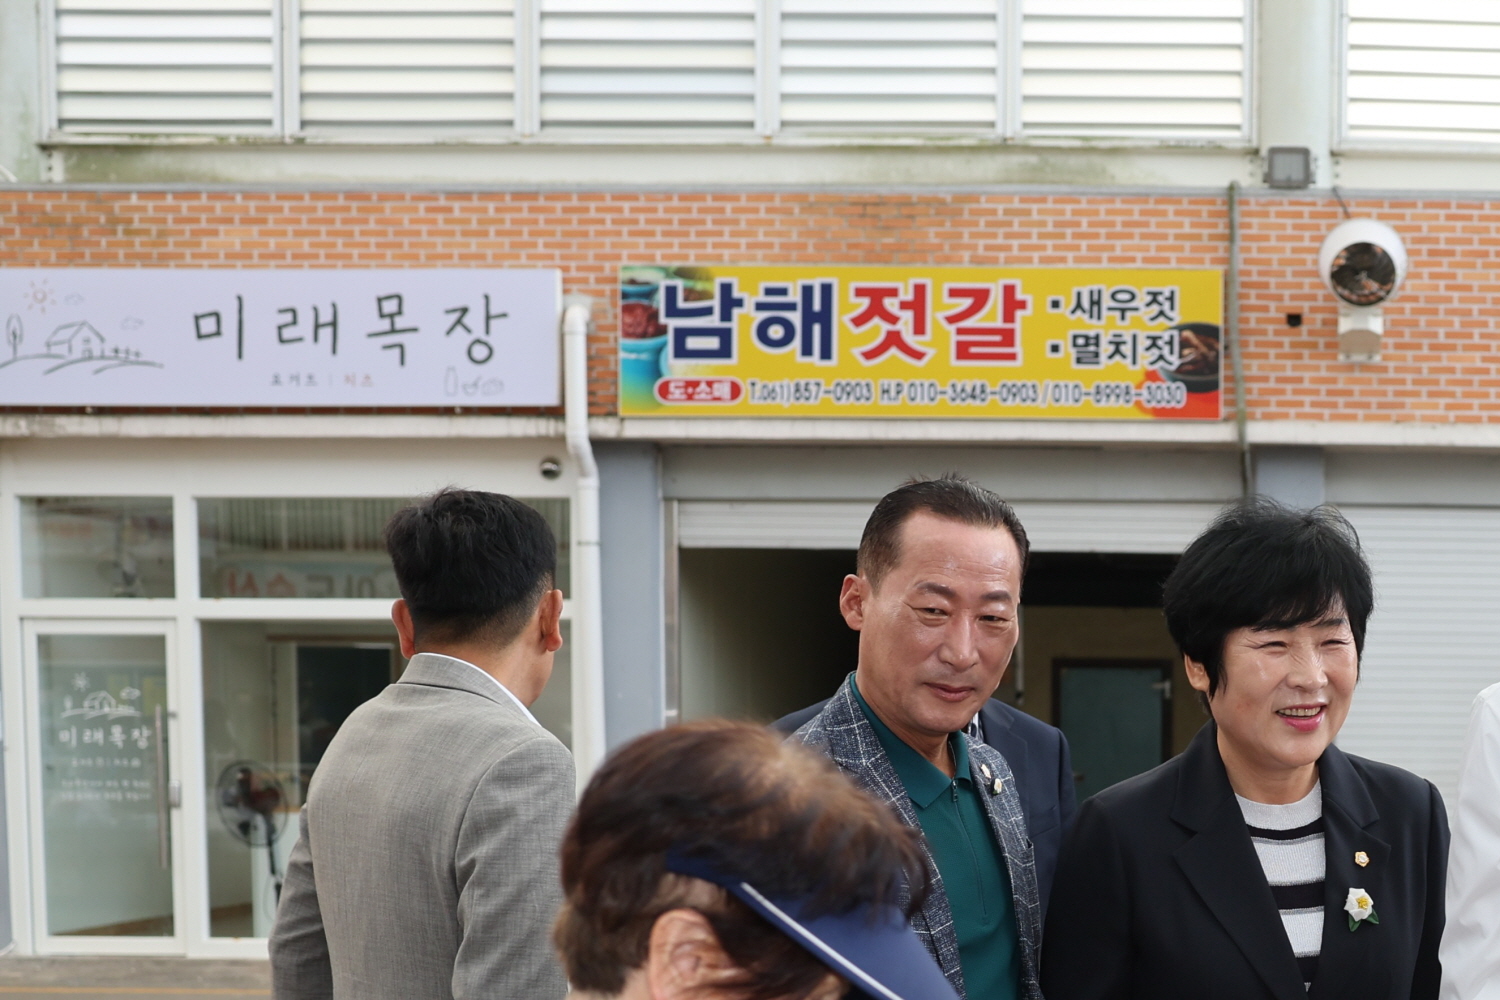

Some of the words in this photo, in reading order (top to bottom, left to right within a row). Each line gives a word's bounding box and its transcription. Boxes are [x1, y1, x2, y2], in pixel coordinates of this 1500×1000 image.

[193, 293, 508, 366] 미래목장
[661, 280, 1029, 363] 남해젓갈
[1069, 287, 1176, 322] 새우젓
[1070, 332, 1176, 366] 멸치젓
